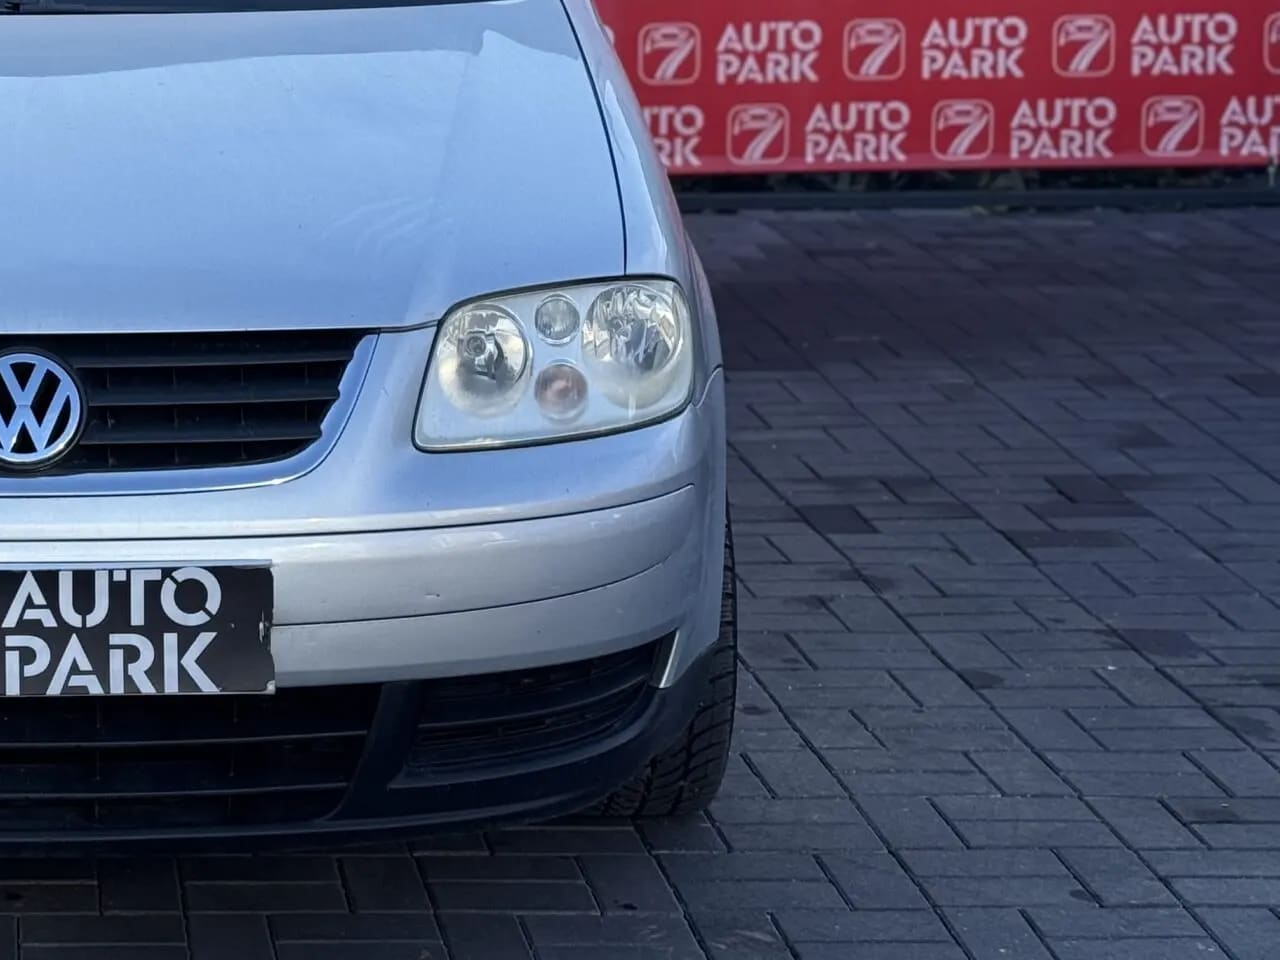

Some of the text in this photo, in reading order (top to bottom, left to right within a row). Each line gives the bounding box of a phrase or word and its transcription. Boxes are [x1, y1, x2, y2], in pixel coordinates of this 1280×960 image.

[717, 20, 822, 53] AUTO
[921, 16, 1027, 49] AUTO
[1131, 13, 1237, 45] AUTO
[717, 51, 818, 84] PARK
[922, 47, 1024, 79] PARK
[1131, 43, 1234, 76] PARK
[805, 101, 911, 132] AUTO
[1010, 97, 1116, 128] AUTO
[805, 132, 907, 163] PARK
[1010, 128, 1113, 159] PARK
[1, 567, 222, 629] AUTO
[5, 632, 223, 696] PARK
